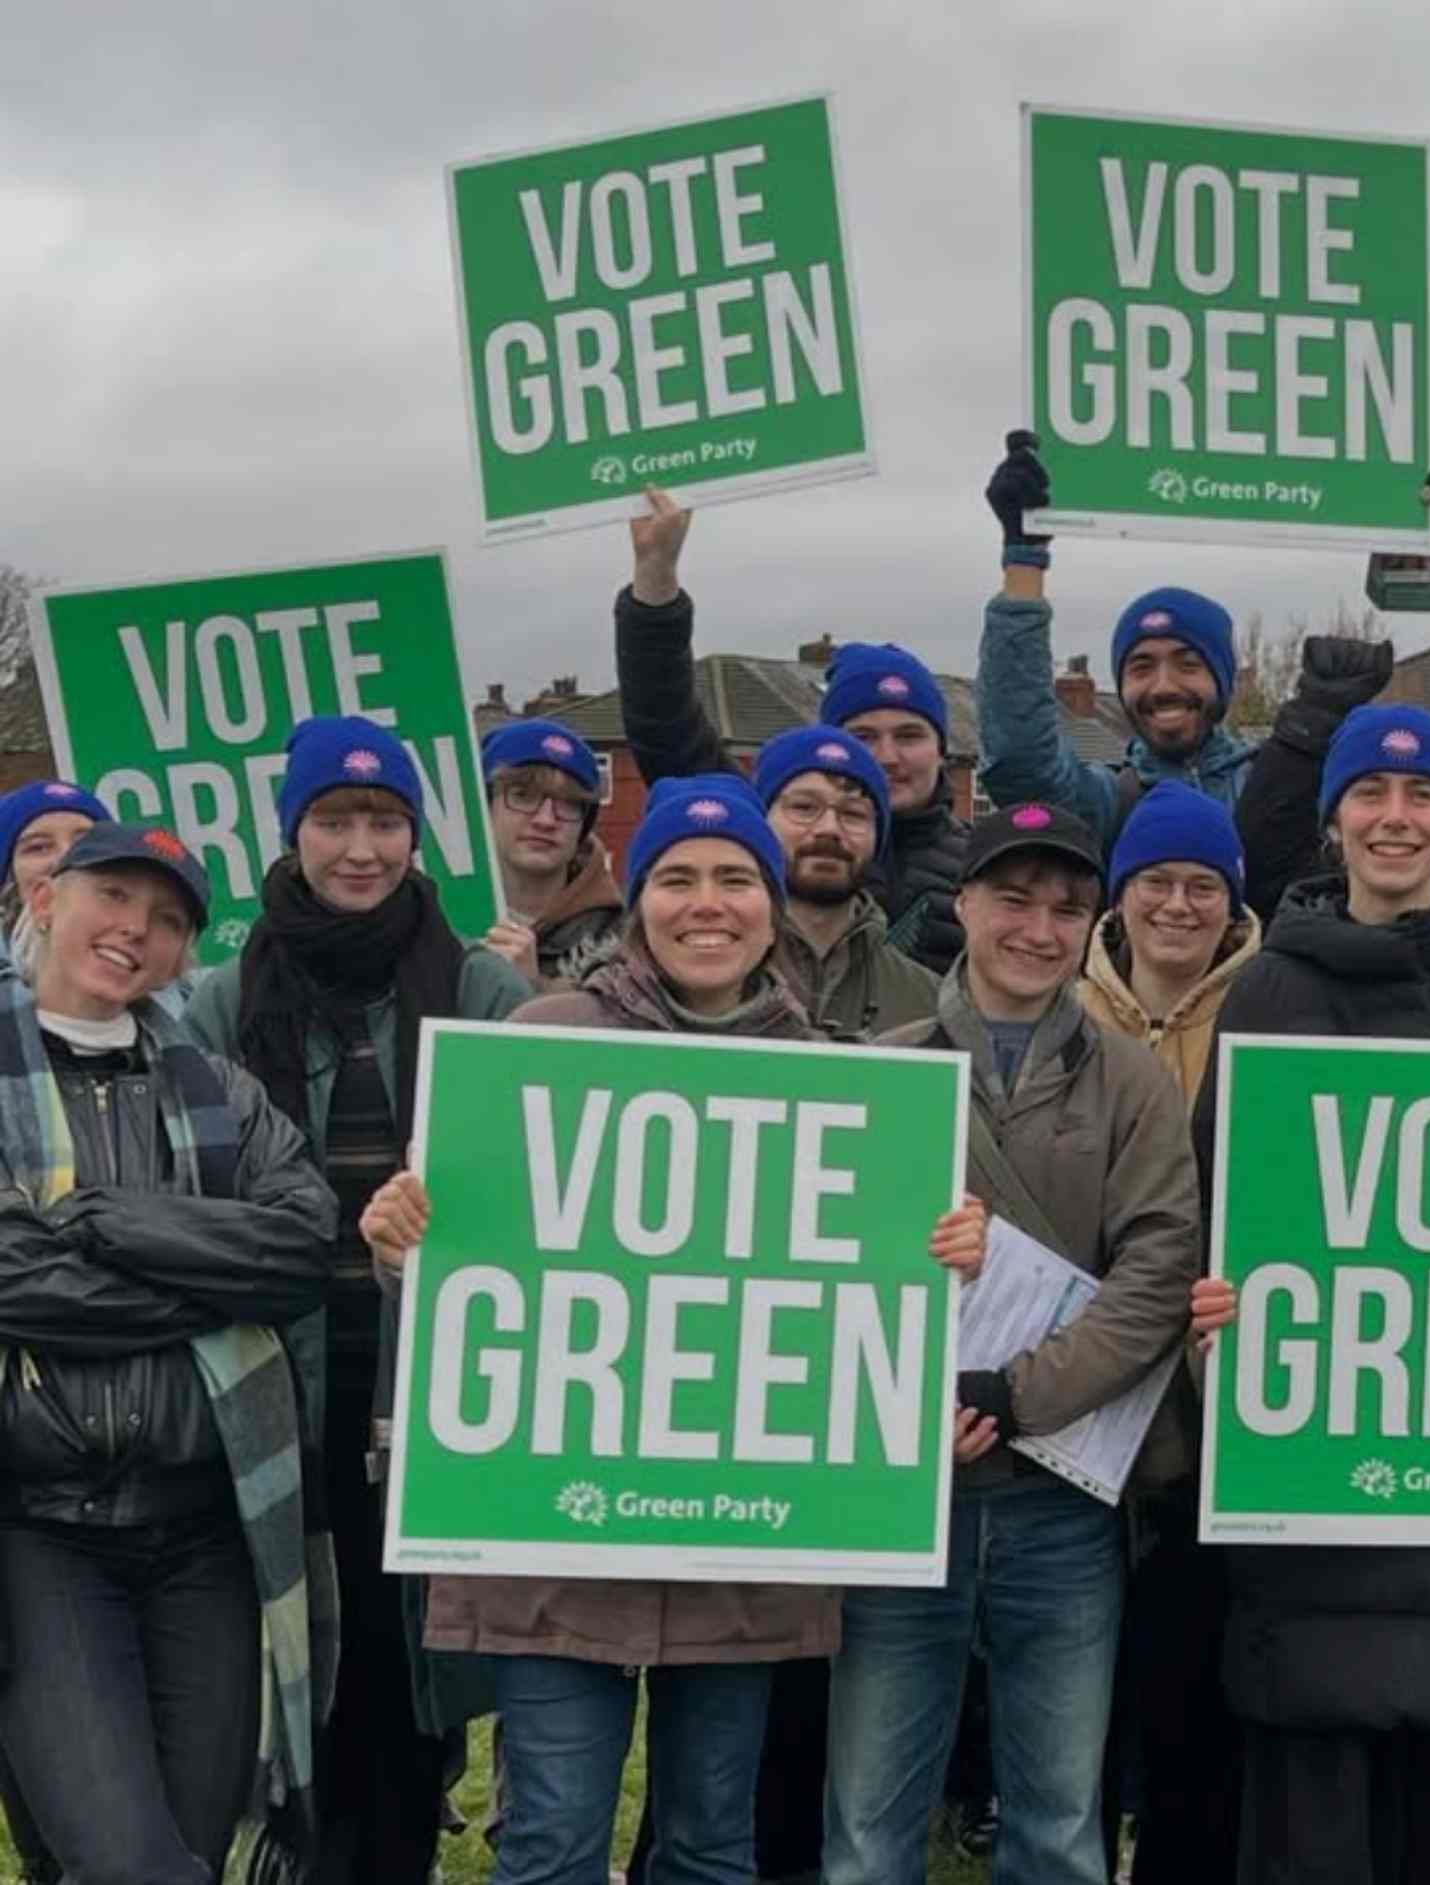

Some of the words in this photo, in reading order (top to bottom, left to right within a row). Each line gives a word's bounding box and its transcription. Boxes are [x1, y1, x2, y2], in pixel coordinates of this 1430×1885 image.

[518, 144, 777, 302] VOTE
[1100, 157, 1360, 304] VOTE
[484, 262, 844, 455] GREEN
[1046, 297, 1415, 465] GREEN
[632, 450, 697, 476] Green
[700, 437, 759, 464] Party
[1193, 477, 1260, 500] Green
[1264, 481, 1323, 511] Party
[118, 600, 397, 753] VOTE
[522, 1084, 868, 1264] VOTE
[427, 1264, 929, 1467] GREEN
[616, 1490, 706, 1520] Green
[713, 1495, 791, 1530] Party
